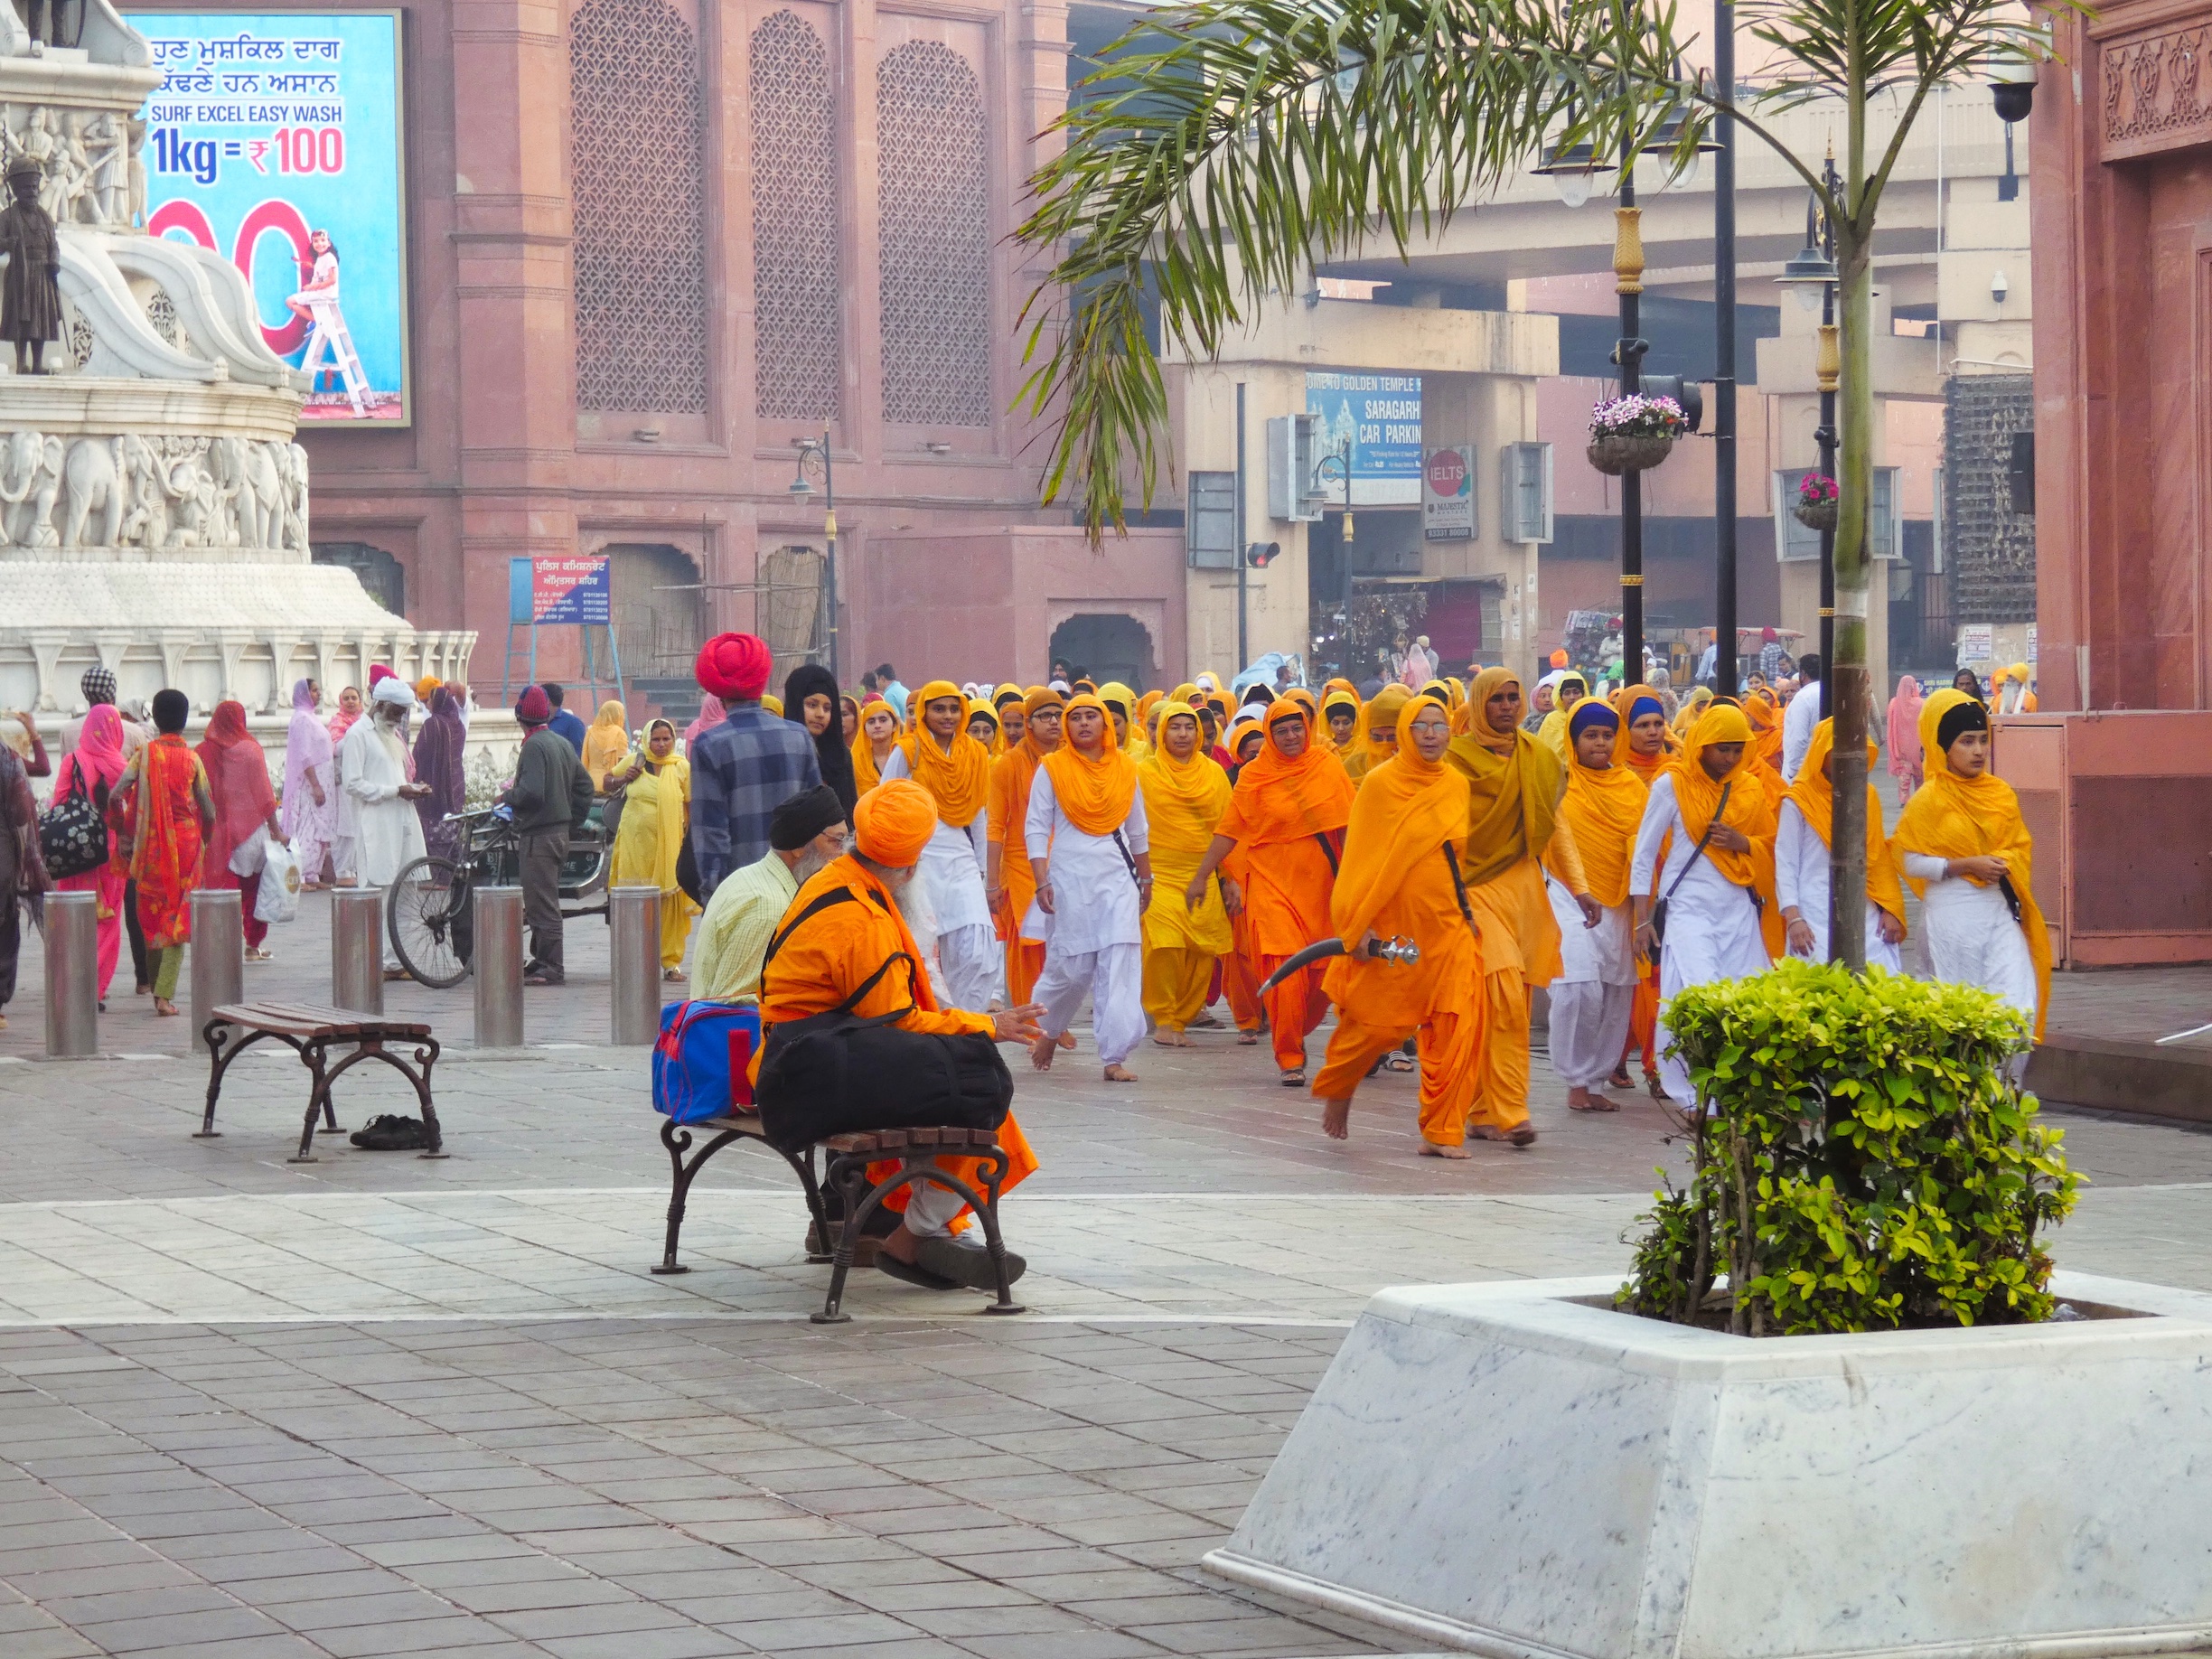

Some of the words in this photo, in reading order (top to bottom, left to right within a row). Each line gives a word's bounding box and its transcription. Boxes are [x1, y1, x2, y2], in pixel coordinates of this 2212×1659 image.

[293, 41, 340, 59] ਦਾਗ
[222, 74, 259, 92] ਹਨ
[268, 74, 336, 92] ਅਸਾਨ
[152, 106, 192, 122] SURF
[198, 106, 244, 122] EXCEL
[248, 106, 288, 122] EASY
[294, 106, 342, 122] WASH
[152, 128, 217, 184] 1kg
[1328, 375, 1340, 390] TO
[1343, 376, 1378, 391] GOLDEN
[1381, 377, 1414, 392] TEMPLE
[1360, 424, 1381, 444] CAR
[1430, 465, 1463, 481] IELTS
[1437, 502, 1468, 511] MAJESTIC
